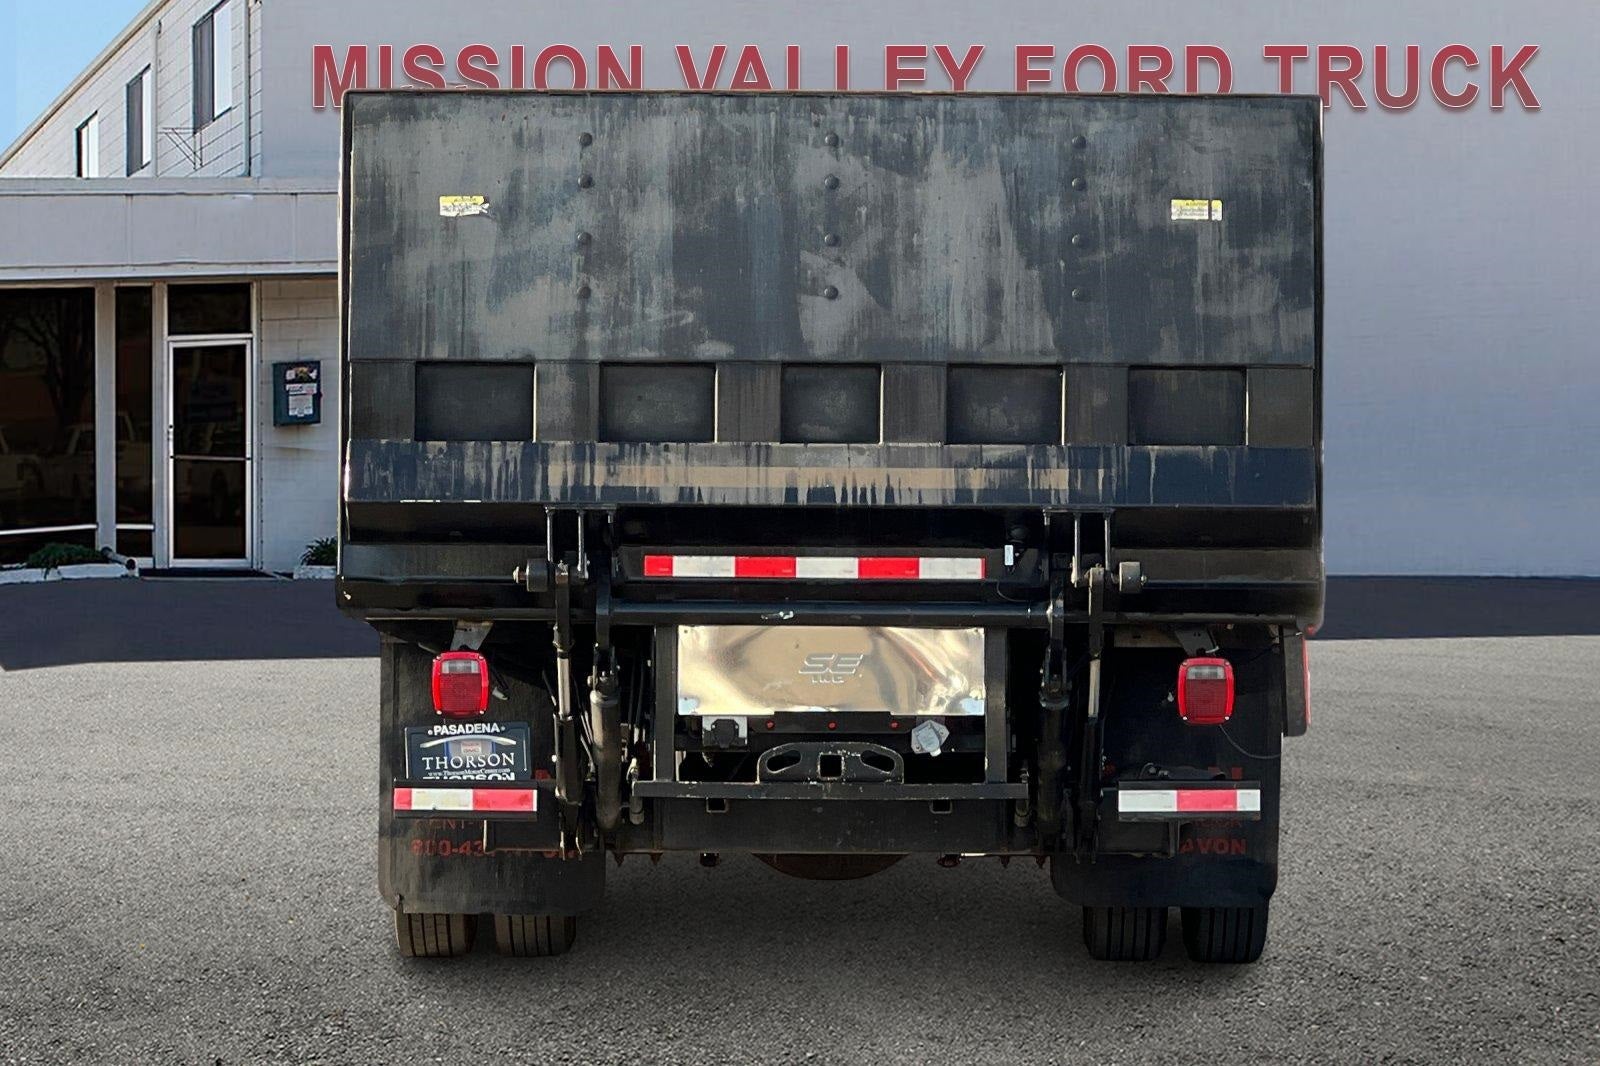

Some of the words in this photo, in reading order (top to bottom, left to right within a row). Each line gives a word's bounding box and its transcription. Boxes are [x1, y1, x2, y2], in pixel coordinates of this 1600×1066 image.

[311, 43, 644, 108] MISSION
[675, 43, 986, 92] VALLEY
[1014, 43, 1235, 94] FORD
[1262, 43, 1543, 109] TRUCK
[433, 722, 501, 736] PASADENA
[421, 752, 516, 771] THORSON
